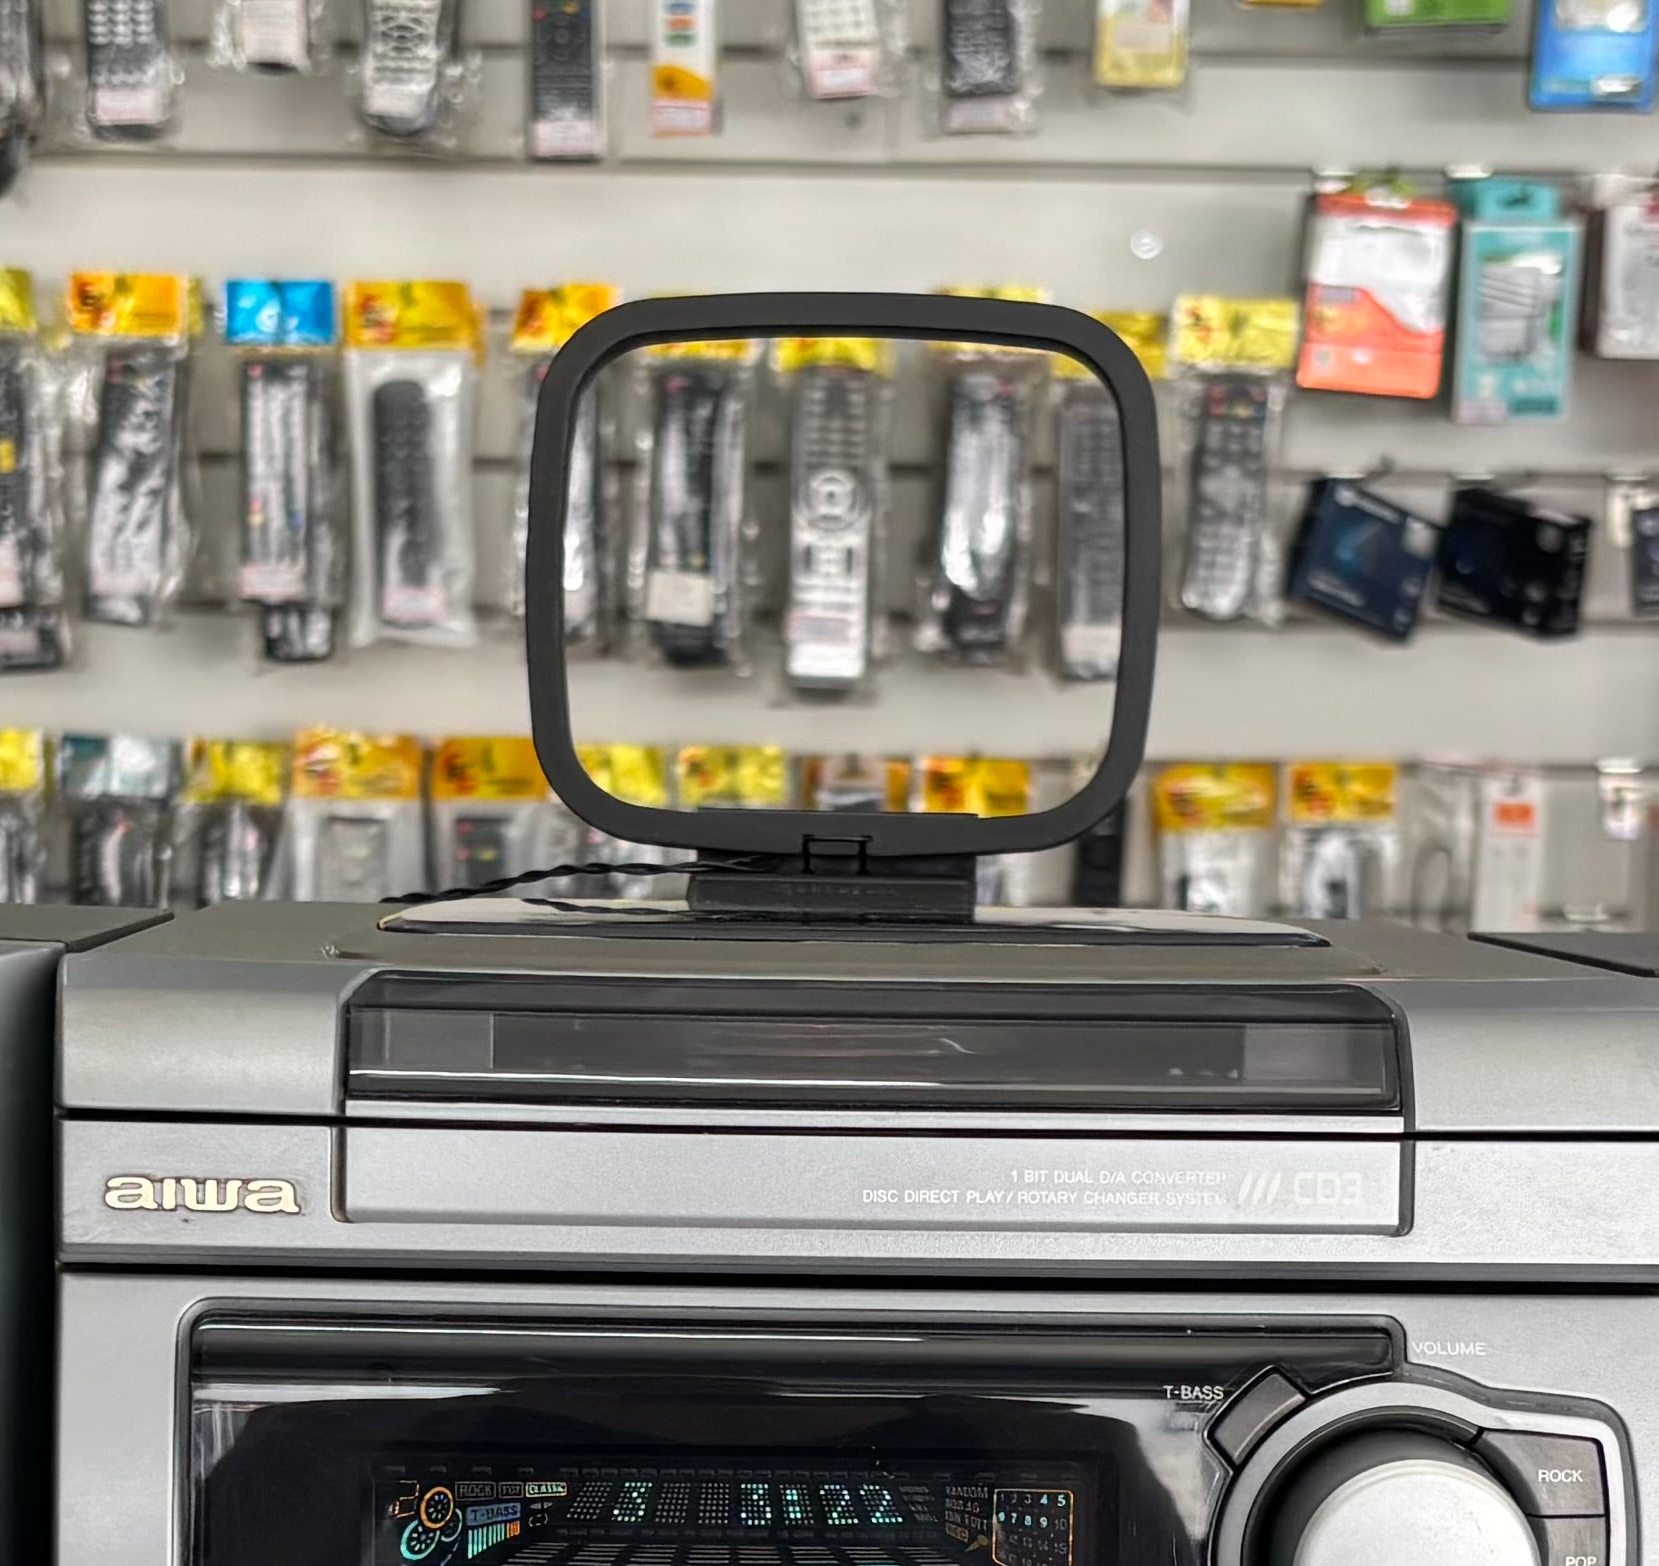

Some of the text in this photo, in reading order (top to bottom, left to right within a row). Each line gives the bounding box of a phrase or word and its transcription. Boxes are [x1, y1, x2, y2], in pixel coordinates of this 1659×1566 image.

[1010, 1171, 1019, 1184] 1
[1024, 1171, 1047, 1185] BIT
[1053, 1171, 1094, 1185] DUAL
[1099, 1171, 1126, 1186] D/A
[1293, 1170, 1362, 1201] CD3
[104, 1175, 301, 1214] aiwa
[862, 1189, 900, 1203] DISC
[904, 1189, 959, 1204] DIRECT
[1083, 1190, 1162, 1206] CHANGER
[1411, 1341, 1488, 1357] VOLUME
[1162, 1384, 1225, 1401] T-BASS
[1536, 1469, 1584, 1484] ROCK
[740, 1483, 904, 1526] 3:22
[1039, 1493, 1049, 1505] 4
[1056, 1493, 1068, 1508] 5
[1039, 1515, 1049, 1529] 9
